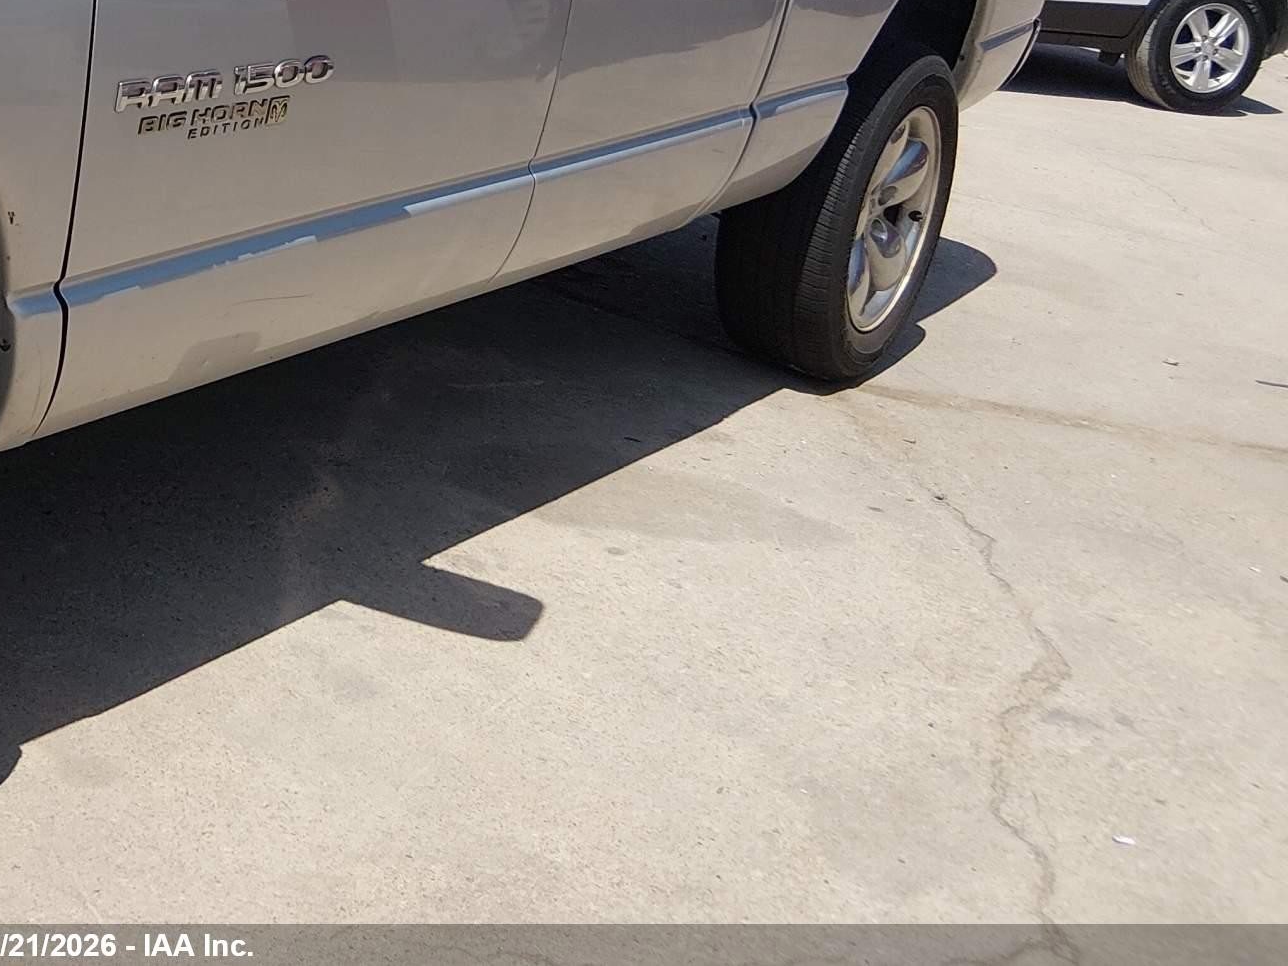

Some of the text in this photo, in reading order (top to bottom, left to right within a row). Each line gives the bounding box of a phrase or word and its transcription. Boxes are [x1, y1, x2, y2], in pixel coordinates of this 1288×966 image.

[115, 54, 335, 113] RAM 1500
[138, 98, 268, 134] BIG HORN
[188, 116, 265, 140] EDITION
